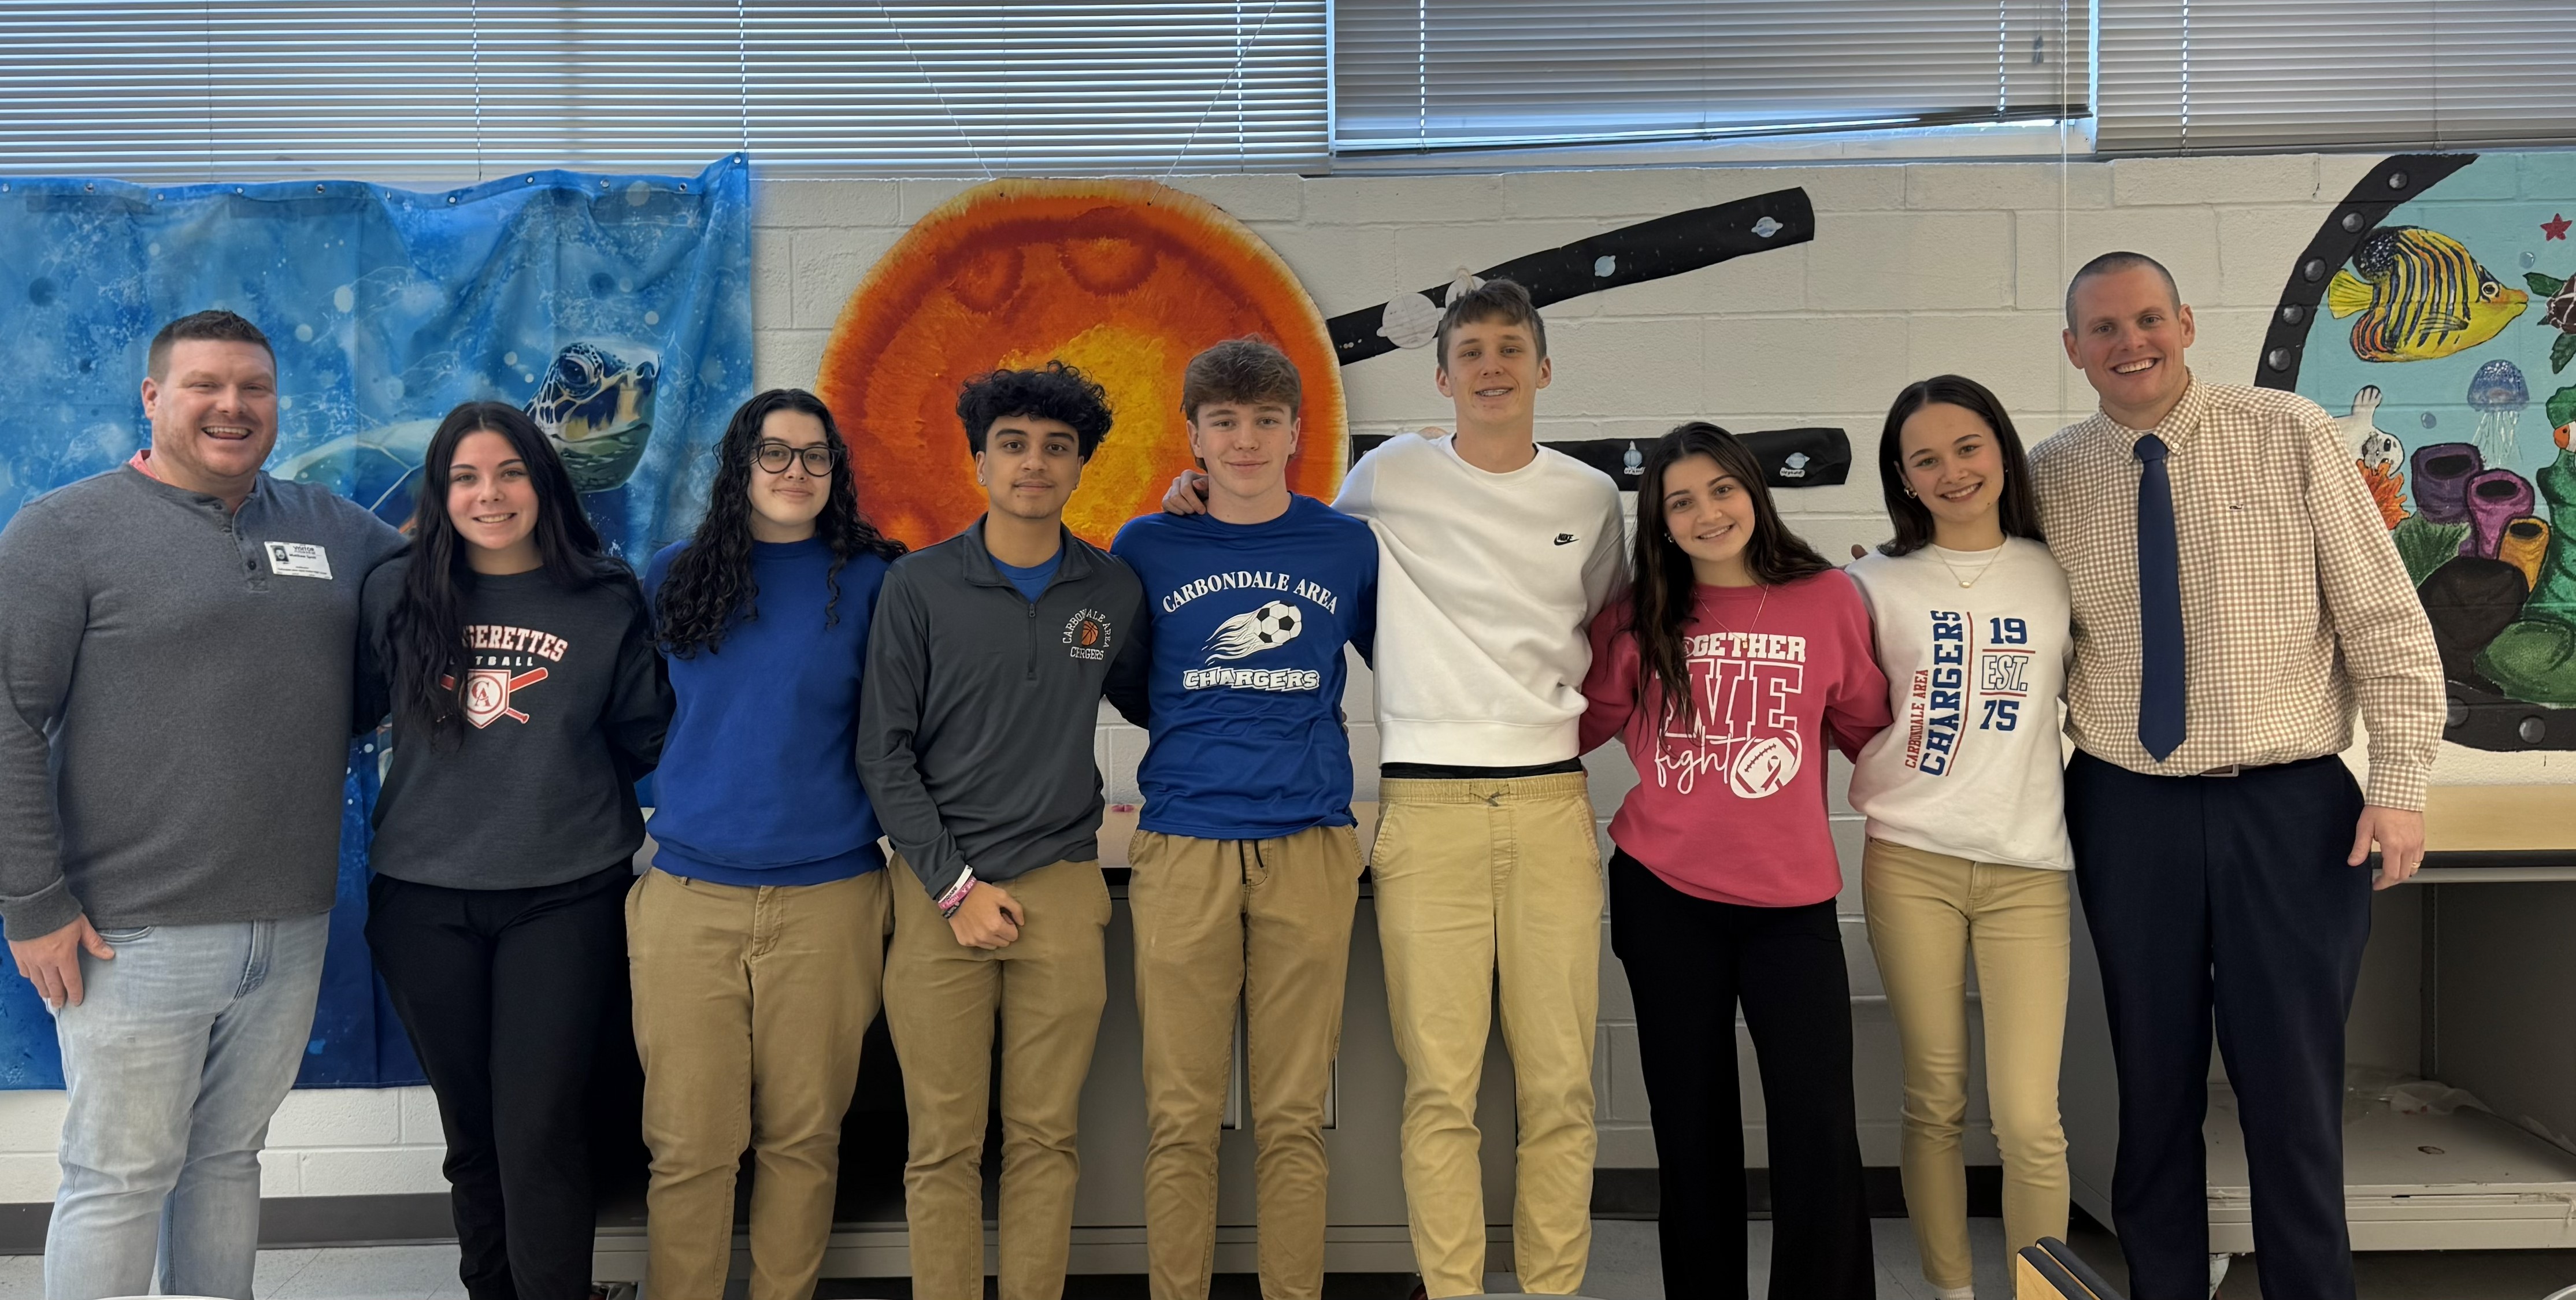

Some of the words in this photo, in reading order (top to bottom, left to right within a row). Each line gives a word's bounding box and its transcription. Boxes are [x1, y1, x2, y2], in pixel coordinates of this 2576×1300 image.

[1162, 571, 1290, 613] CARBONDALE
[1293, 579, 1338, 615] AREA
[1102, 623, 1111, 648] AREA
[1990, 617, 2028, 644] 19
[475, 656, 533, 667] TBALL
[1981, 655, 2029, 692] EST.
[1183, 666, 1320, 692] CHARGERS
[1913, 669, 1929, 699] AREA
[1919, 610, 1963, 776] CHARGERS
[1980, 699, 2020, 731] 75
[1905, 703, 1925, 768] CARBONDALE
[1655, 726, 1747, 795] fight
